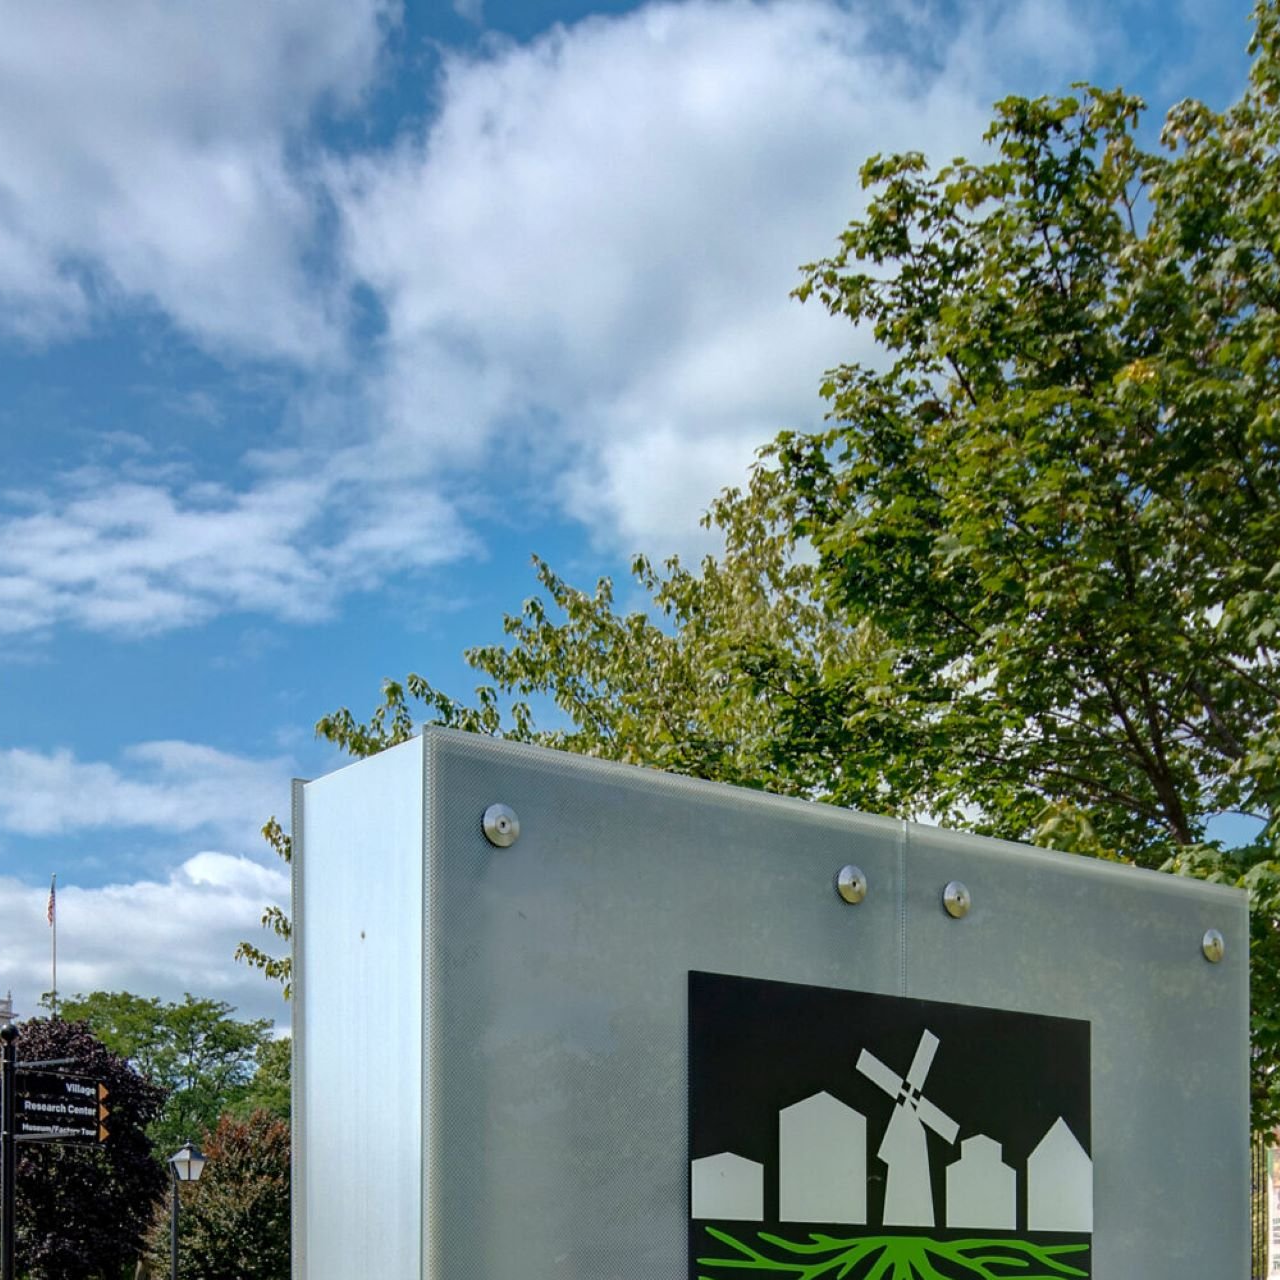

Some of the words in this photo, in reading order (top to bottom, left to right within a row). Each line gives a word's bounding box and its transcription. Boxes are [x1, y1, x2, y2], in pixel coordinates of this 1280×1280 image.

[65, 1083, 97, 1096] Village
[24, 1100, 66, 1113] Research
[68, 1104, 97, 1116] Center
